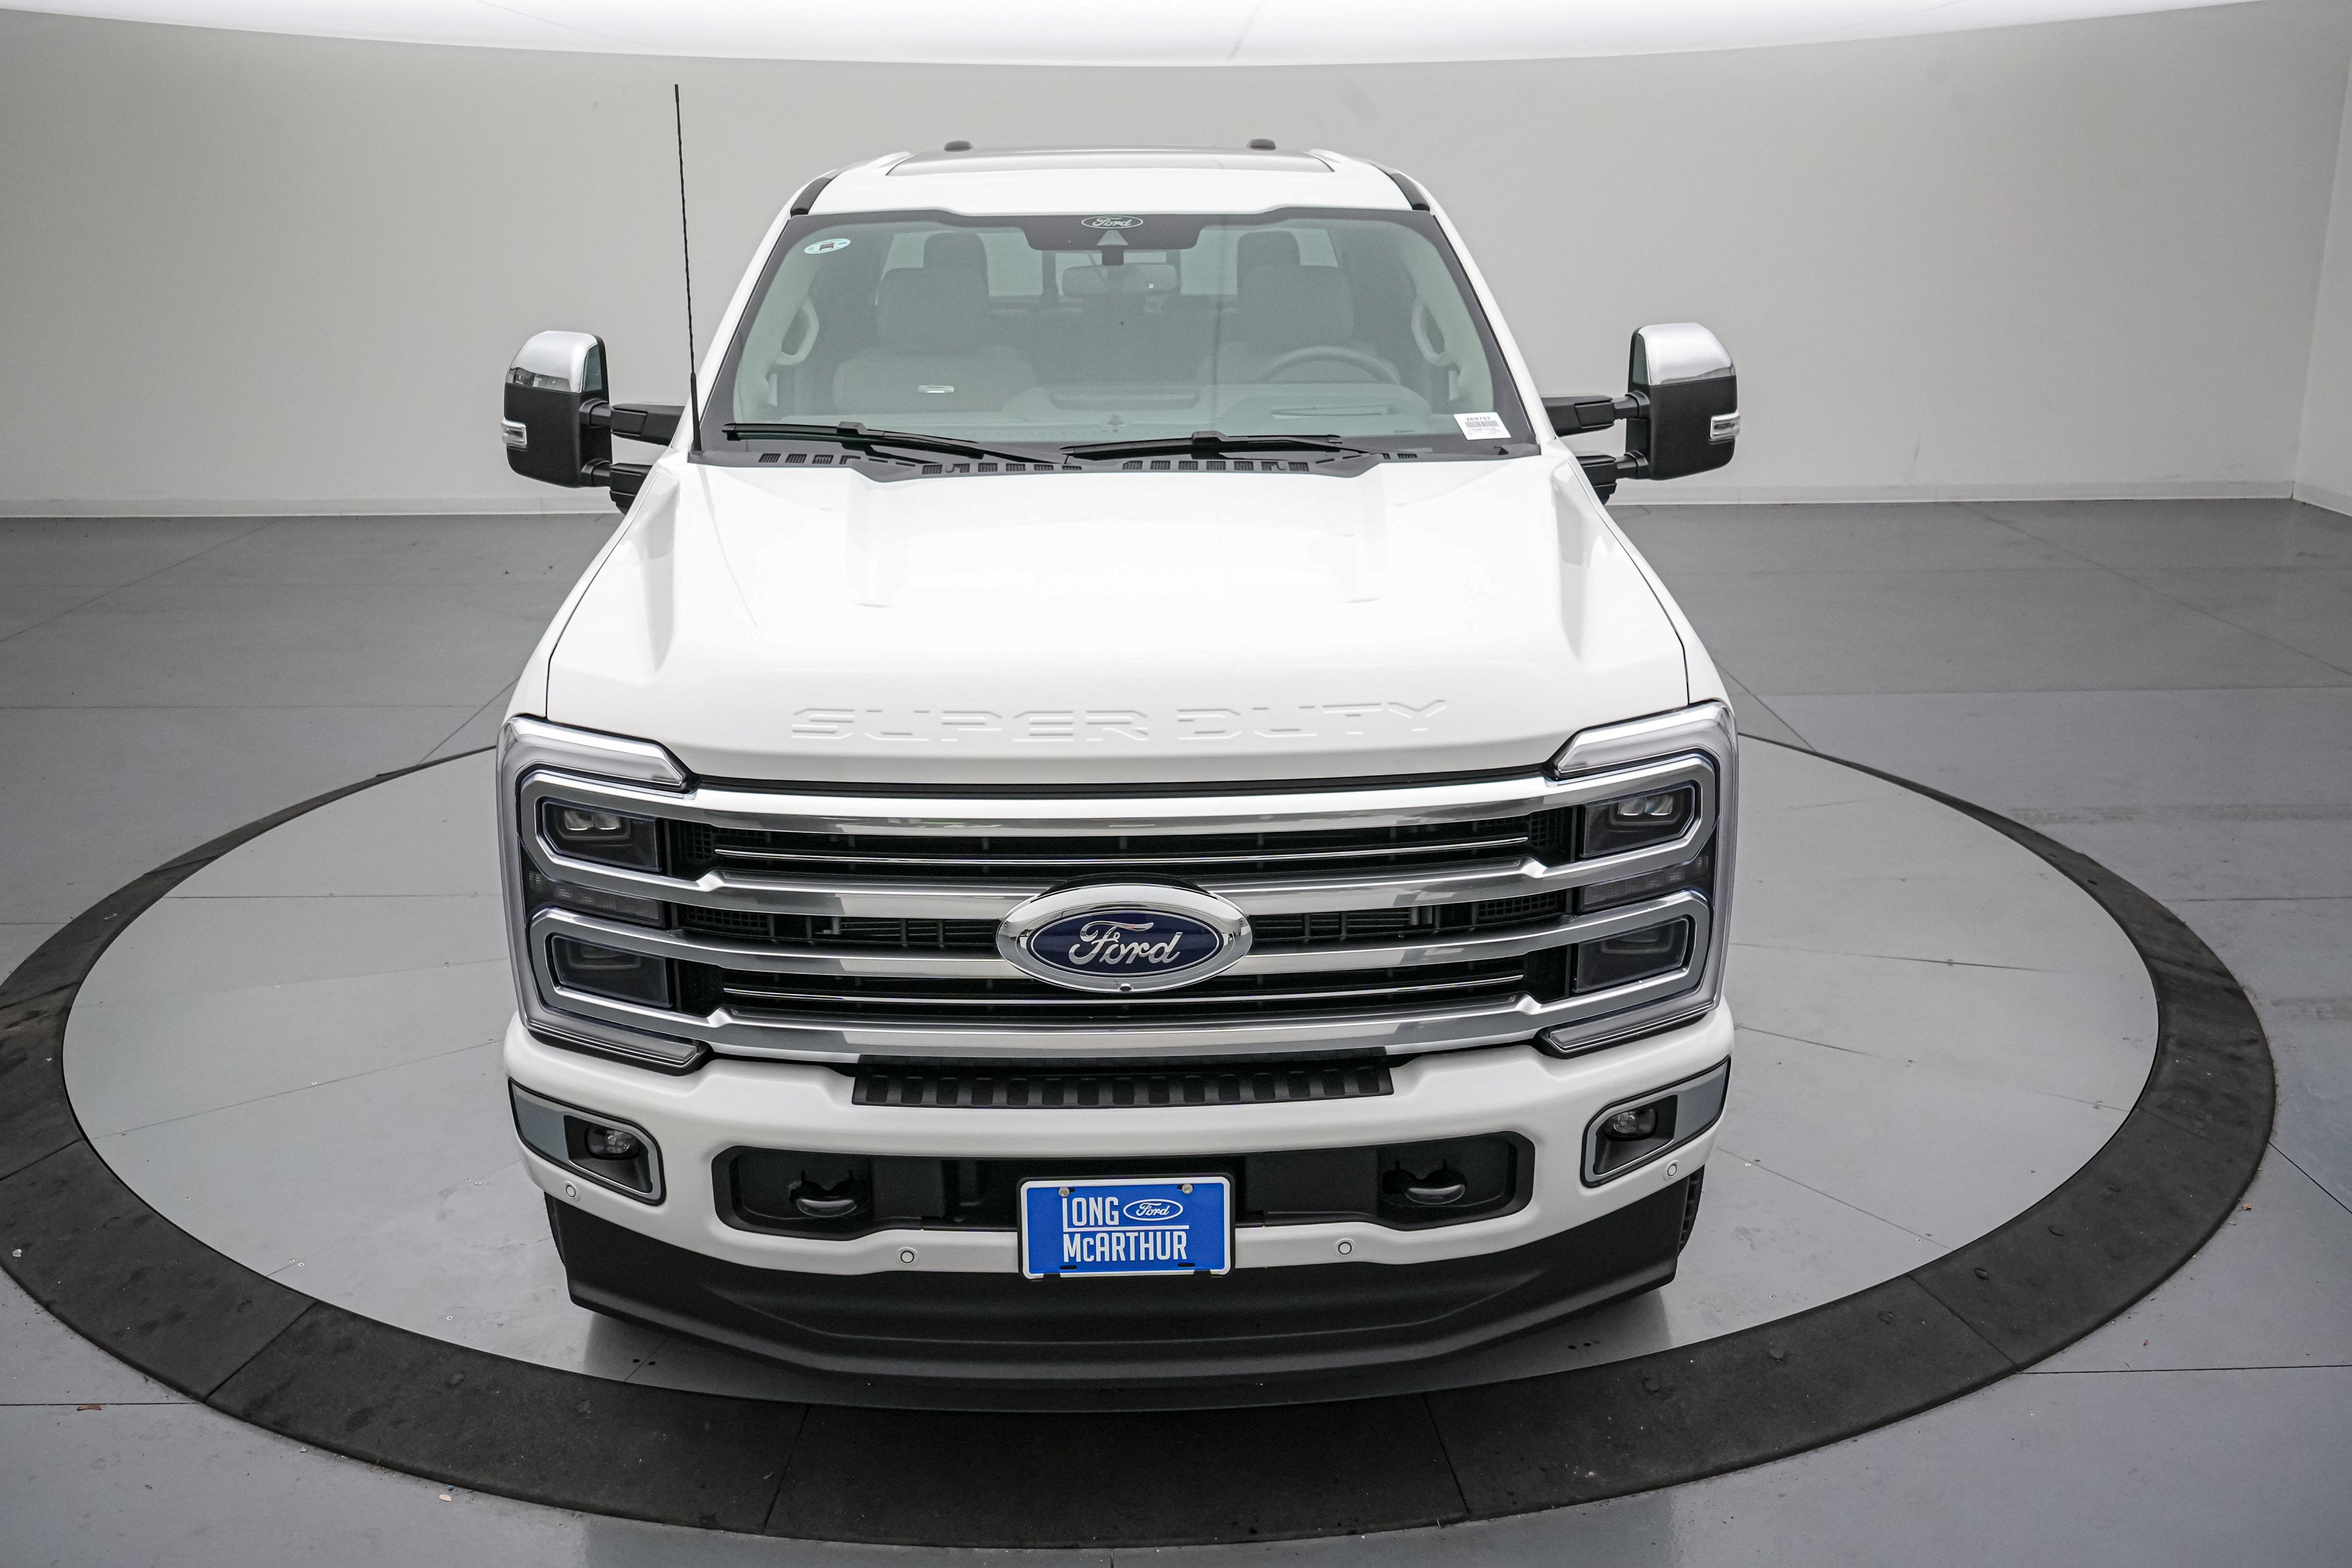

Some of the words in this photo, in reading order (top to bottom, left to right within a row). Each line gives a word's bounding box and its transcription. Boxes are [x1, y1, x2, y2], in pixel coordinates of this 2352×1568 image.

[1092, 217, 1132, 227] Ford
[791, 708, 1149, 741] SUPER
[1177, 699, 1447, 740] DUTY
[1068, 920, 1182, 965] Ford
[1063, 1196, 1120, 1230] LONG
[1135, 1201, 1170, 1216] Ford
[1063, 1231, 1188, 1262] McARTHUR
